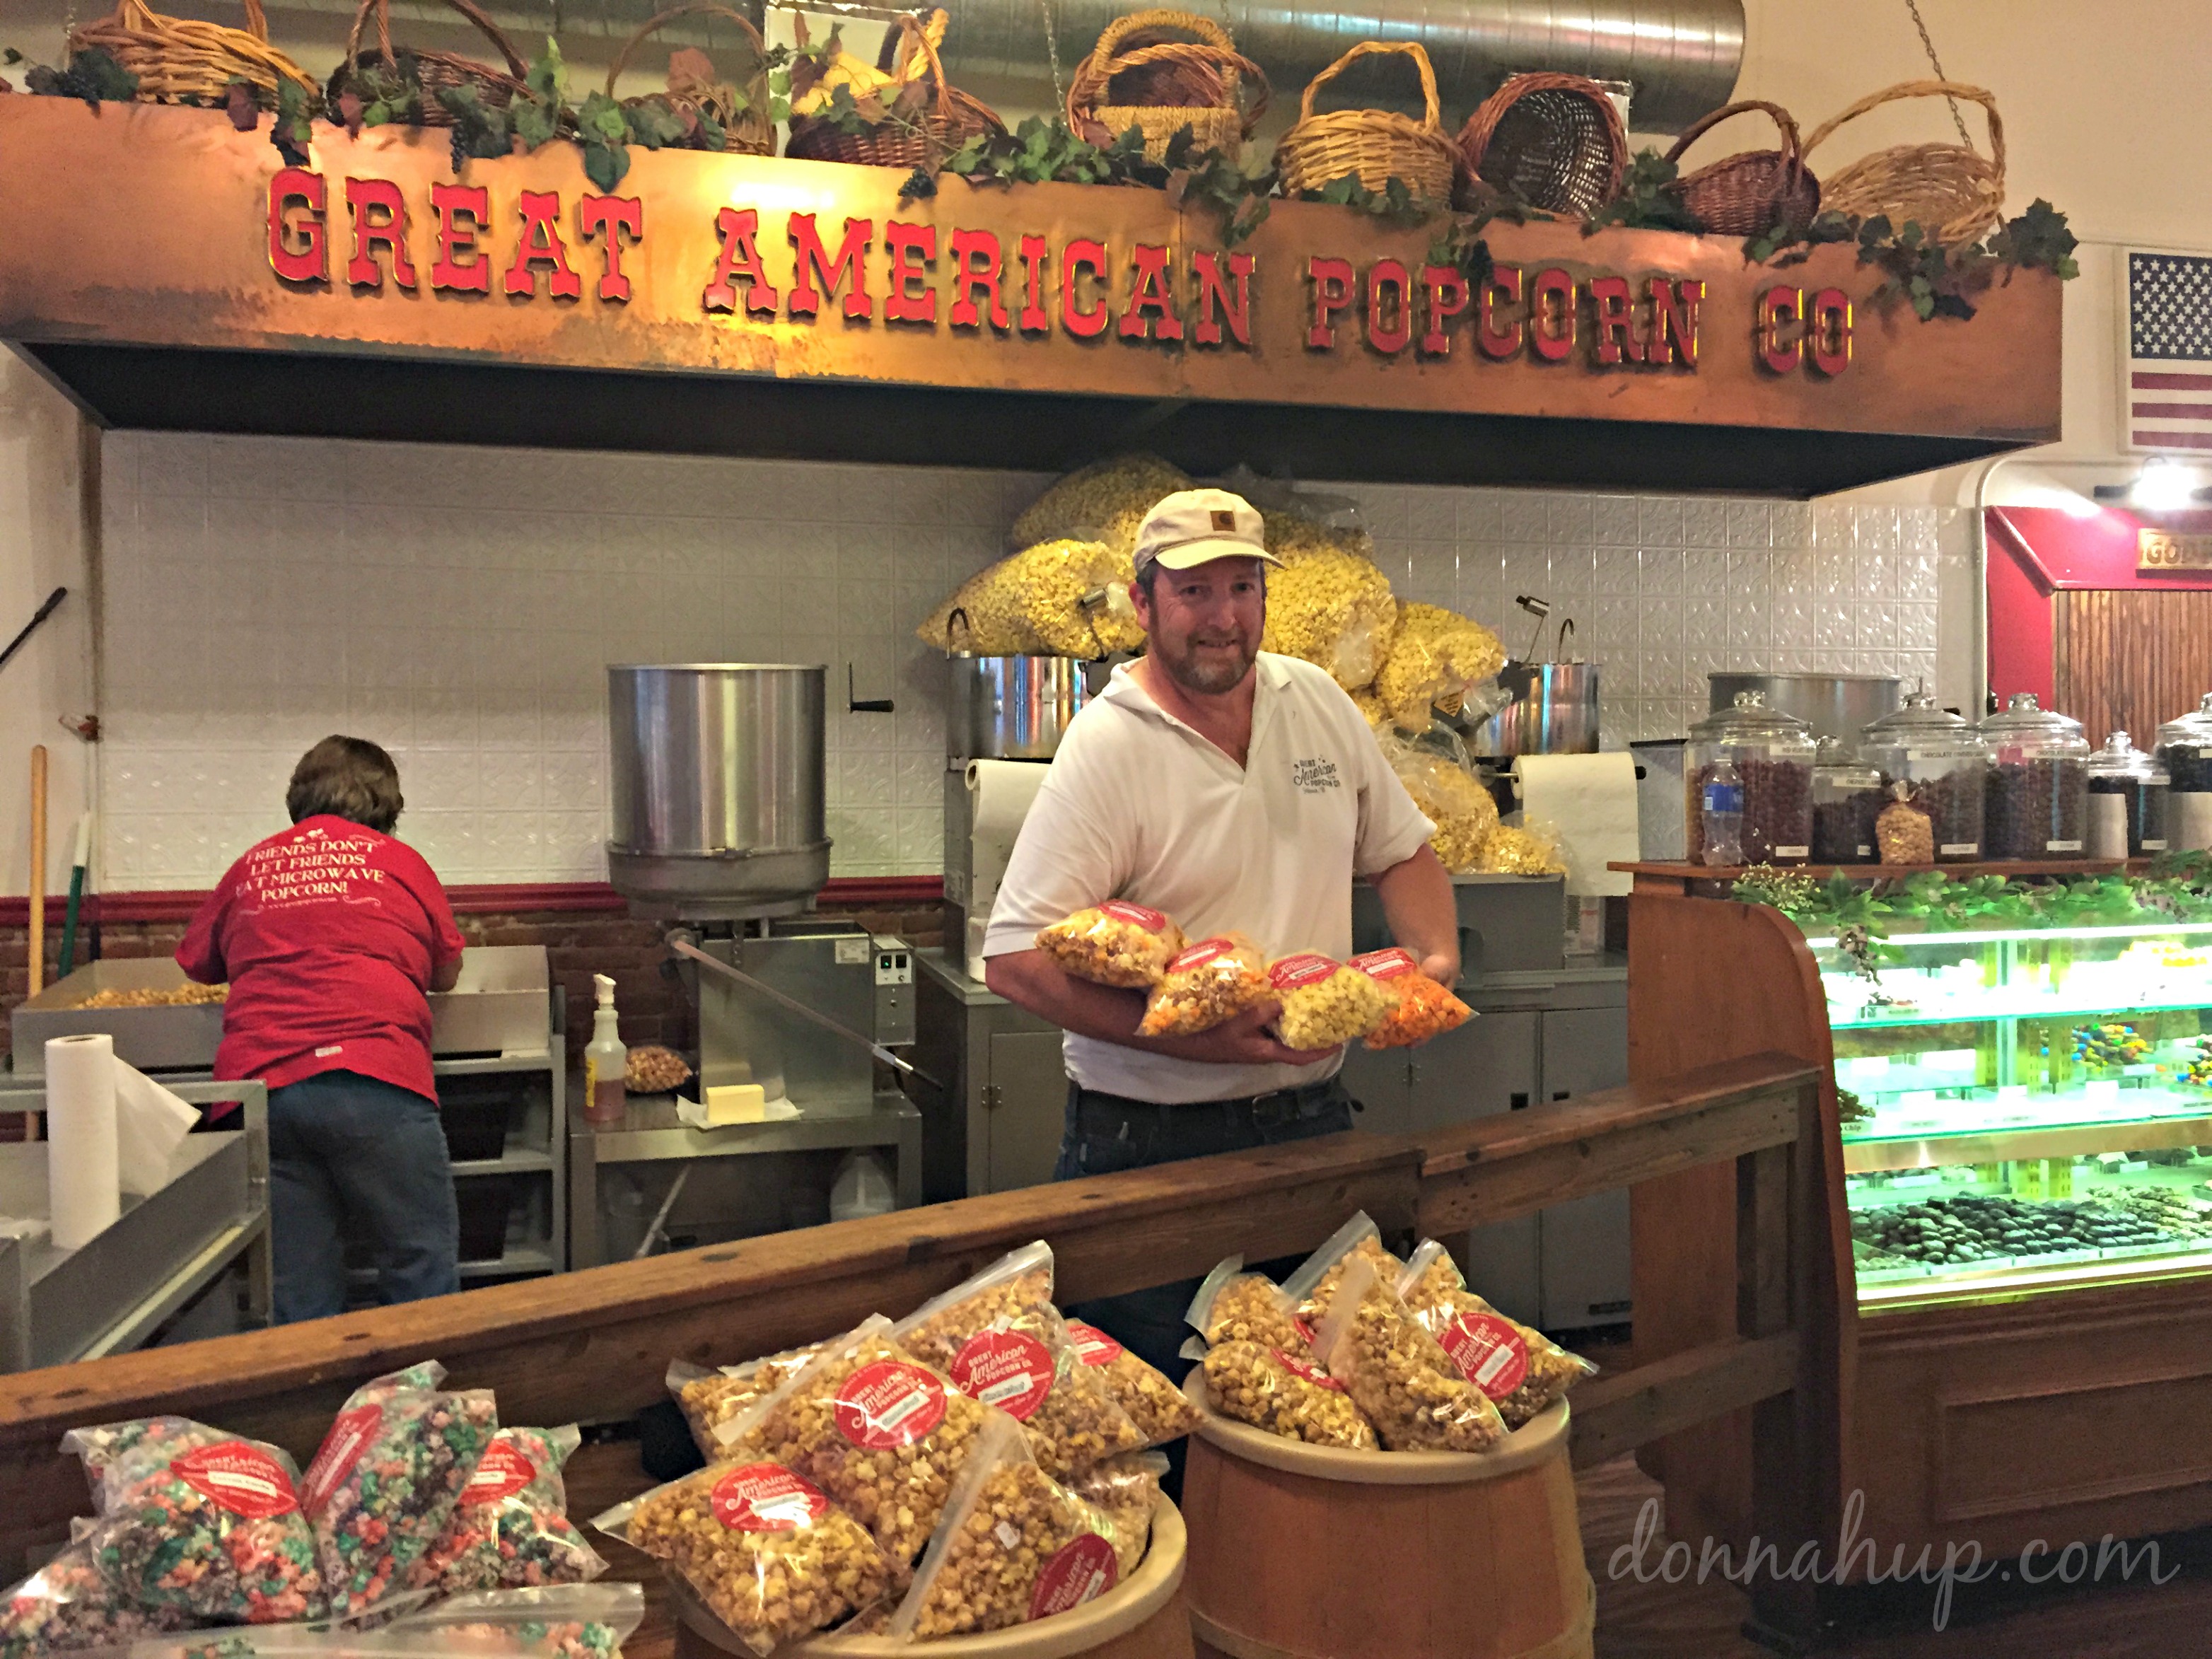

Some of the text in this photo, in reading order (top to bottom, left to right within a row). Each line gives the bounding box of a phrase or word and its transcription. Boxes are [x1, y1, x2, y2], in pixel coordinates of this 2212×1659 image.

[267, 167, 1853, 376] GREAT AMERICAN POPCORN CO
[320, 840, 373, 853] DON'T
[250, 853, 366, 876] LET FRIENDS
[261, 881, 347, 902] POPCORN!
